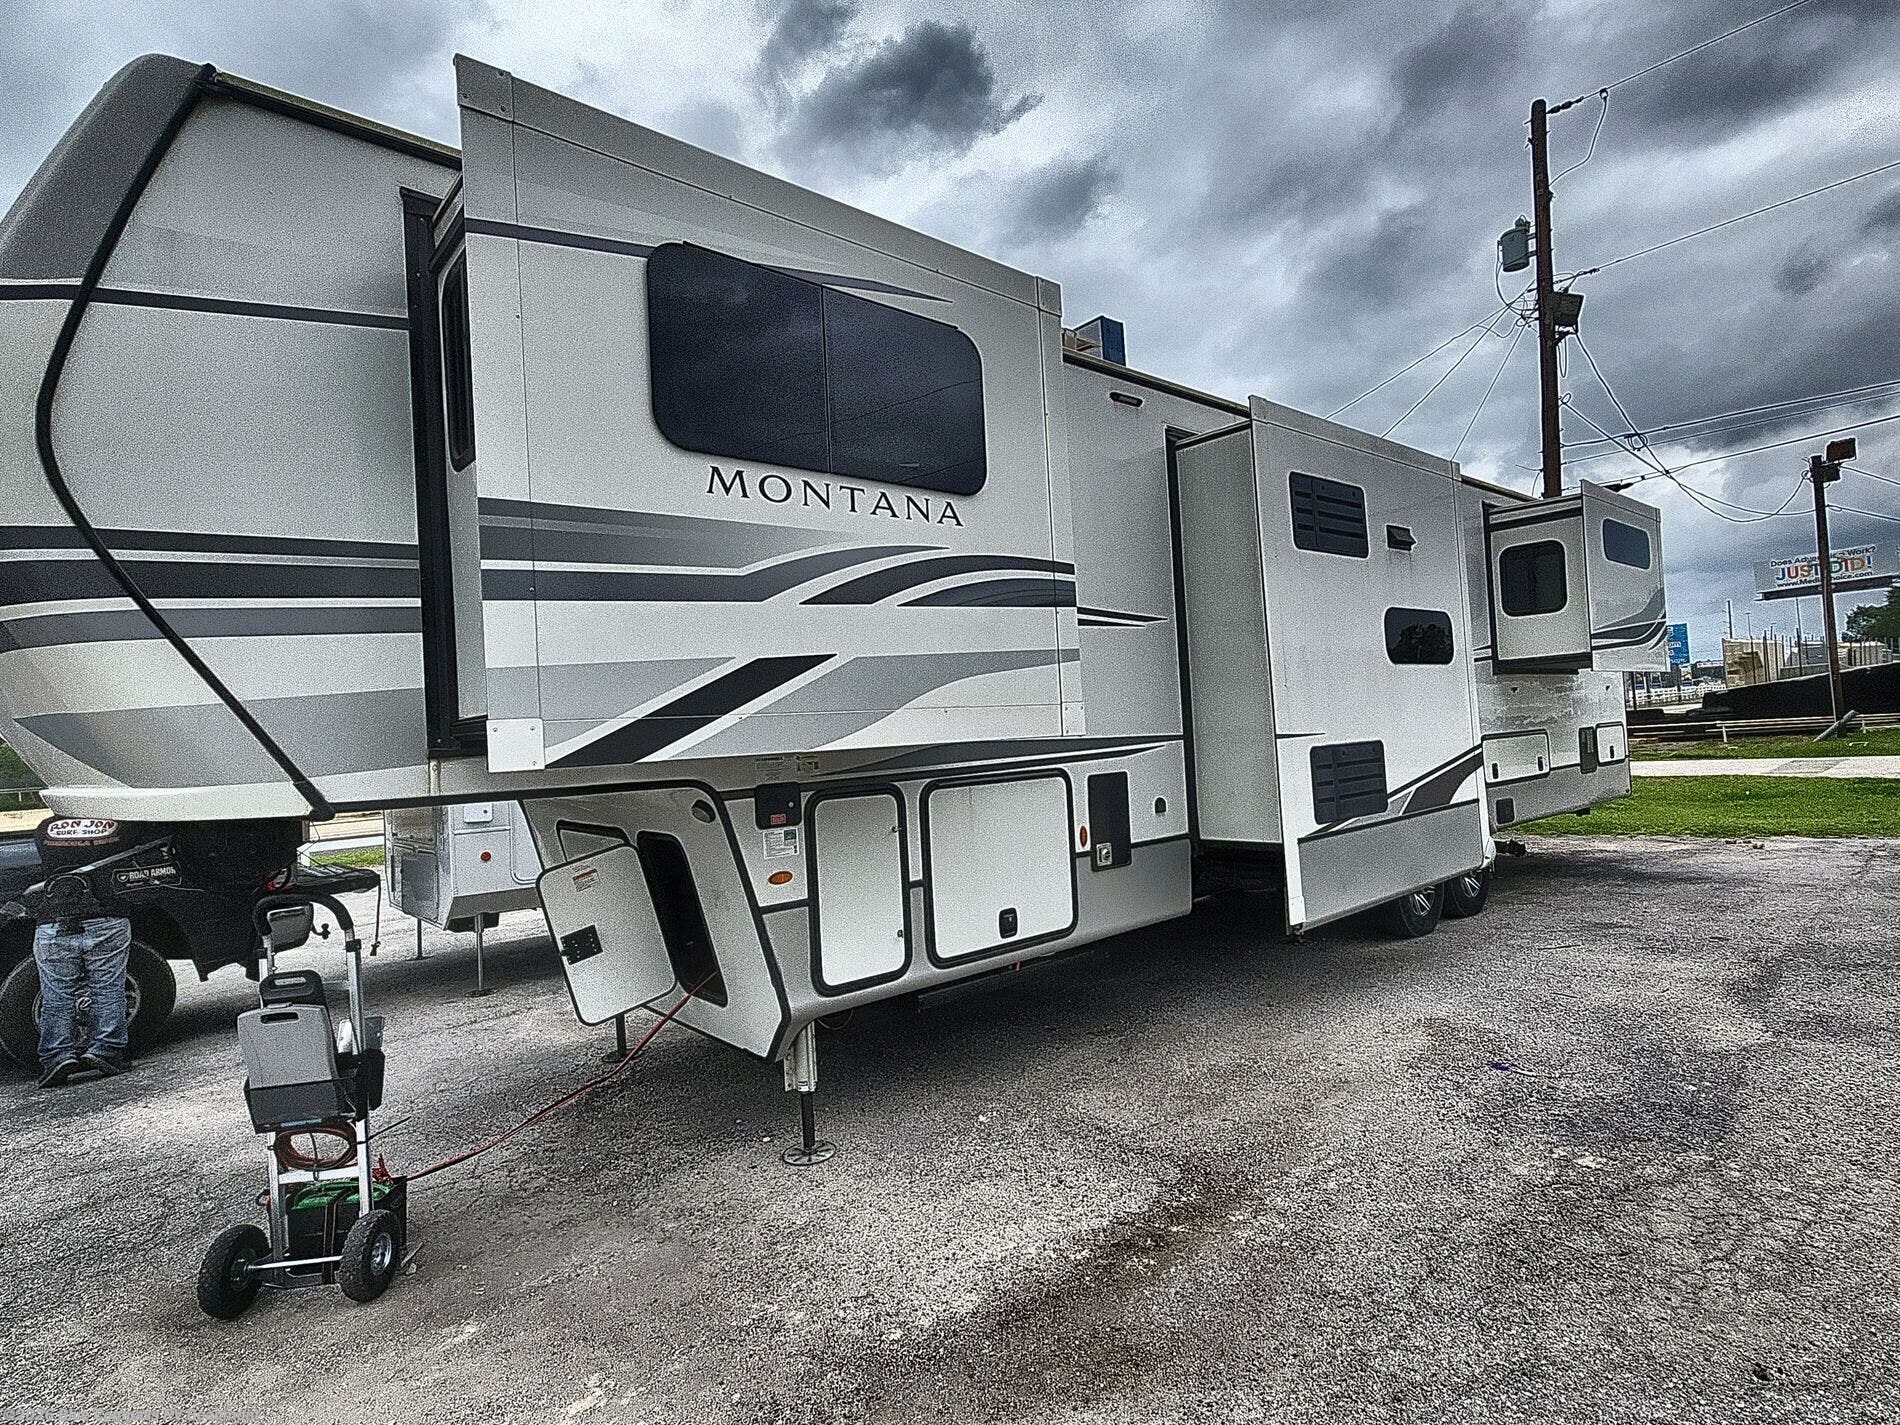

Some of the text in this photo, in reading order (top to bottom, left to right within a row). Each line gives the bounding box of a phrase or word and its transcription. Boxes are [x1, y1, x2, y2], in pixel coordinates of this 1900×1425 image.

[706, 465, 964, 527] MONTANA
[1770, 559, 1792, 567] Does
[1847, 546, 1877, 556] Work?
[1775, 555, 1872, 581] JUST DID!
[50, 820, 115, 833] RON JON
[150, 866, 177, 877] ARMOR
